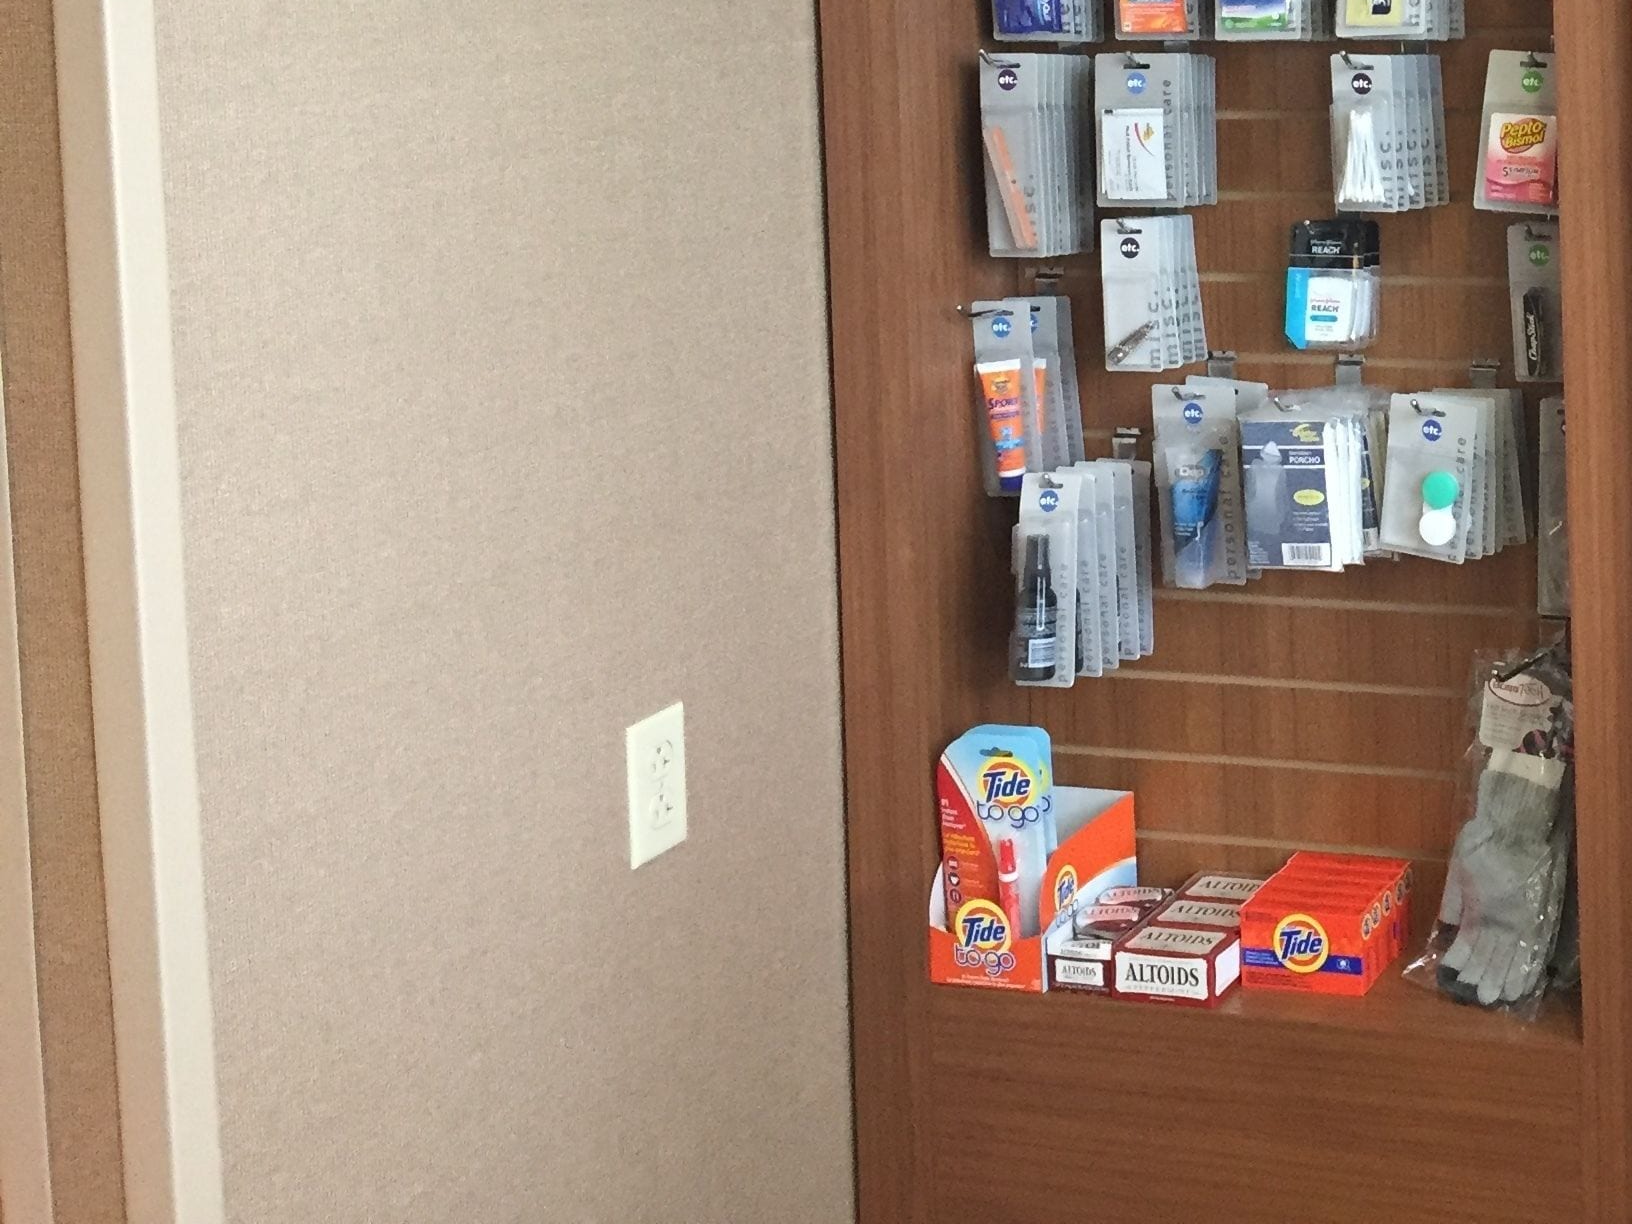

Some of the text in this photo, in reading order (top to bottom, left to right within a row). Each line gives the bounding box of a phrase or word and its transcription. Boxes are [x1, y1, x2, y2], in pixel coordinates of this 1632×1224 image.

[998, 75, 1018, 85] etc.
[1127, 78, 1147, 88] etc.
[1352, 79, 1372, 89] etc.
[1162, 79, 1174, 115] care
[1501, 119, 1542, 138] Pepto
[1504, 131, 1544, 148] Bismol
[1120, 243, 1140, 253] etc.
[1311, 245, 1341, 254] REACH
[1310, 303, 1339, 313] REACH
[992, 323, 1011, 332] etc.
[1183, 408, 1202, 419] etc.
[1422, 425, 1442, 436] etc.
[983, 770, 1031, 802] Tide
[976, 800, 1004, 821] to
[1007, 806, 1040, 828] go
[962, 916, 1006, 947] Tide
[1143, 932, 1213, 946] ALTOIDS
[1280, 929, 1323, 961] Tide
[1062, 965, 1097, 977] ALTOIDS
[1125, 962, 1200, 987] ALTOIDS
